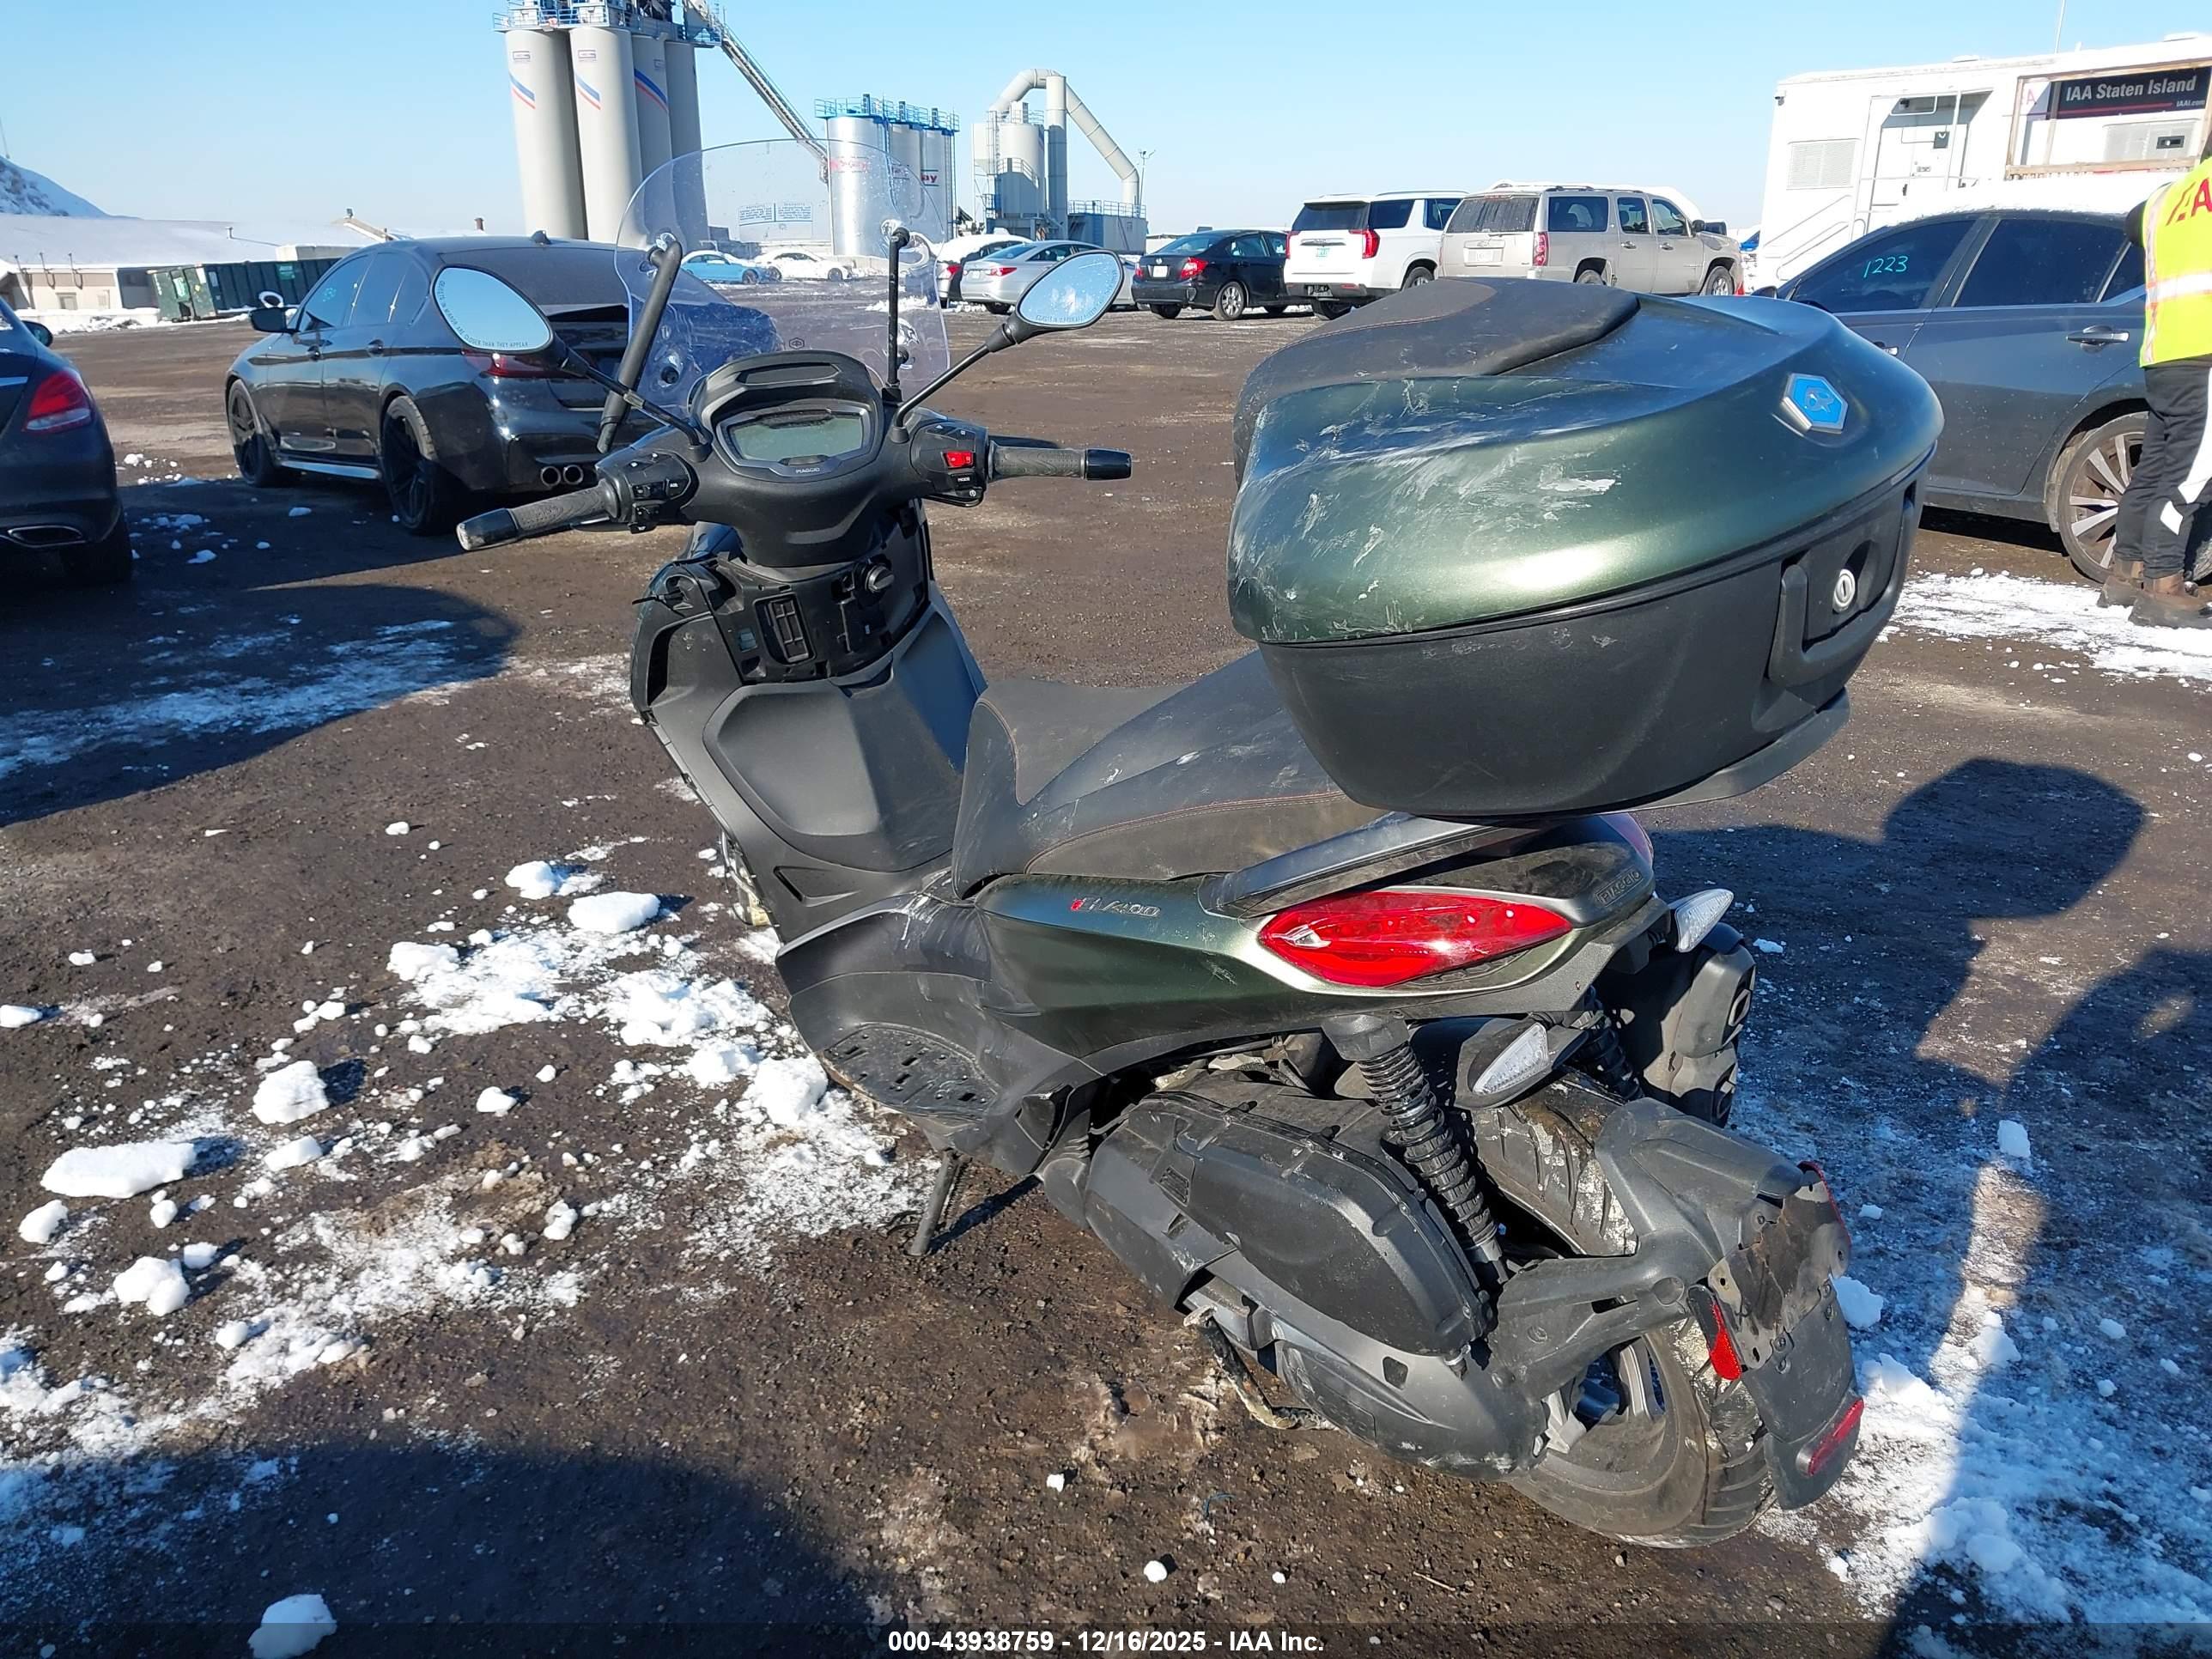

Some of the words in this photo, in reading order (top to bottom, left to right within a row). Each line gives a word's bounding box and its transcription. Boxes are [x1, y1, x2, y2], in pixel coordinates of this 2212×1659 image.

[2066, 85, 2092, 101] IAA
[2096, 83, 2143, 100] Staten
[2148, 75, 2197, 94] Island
[1863, 256, 1908, 278] 1223
[1598, 870, 1640, 904] PIAGGIO
